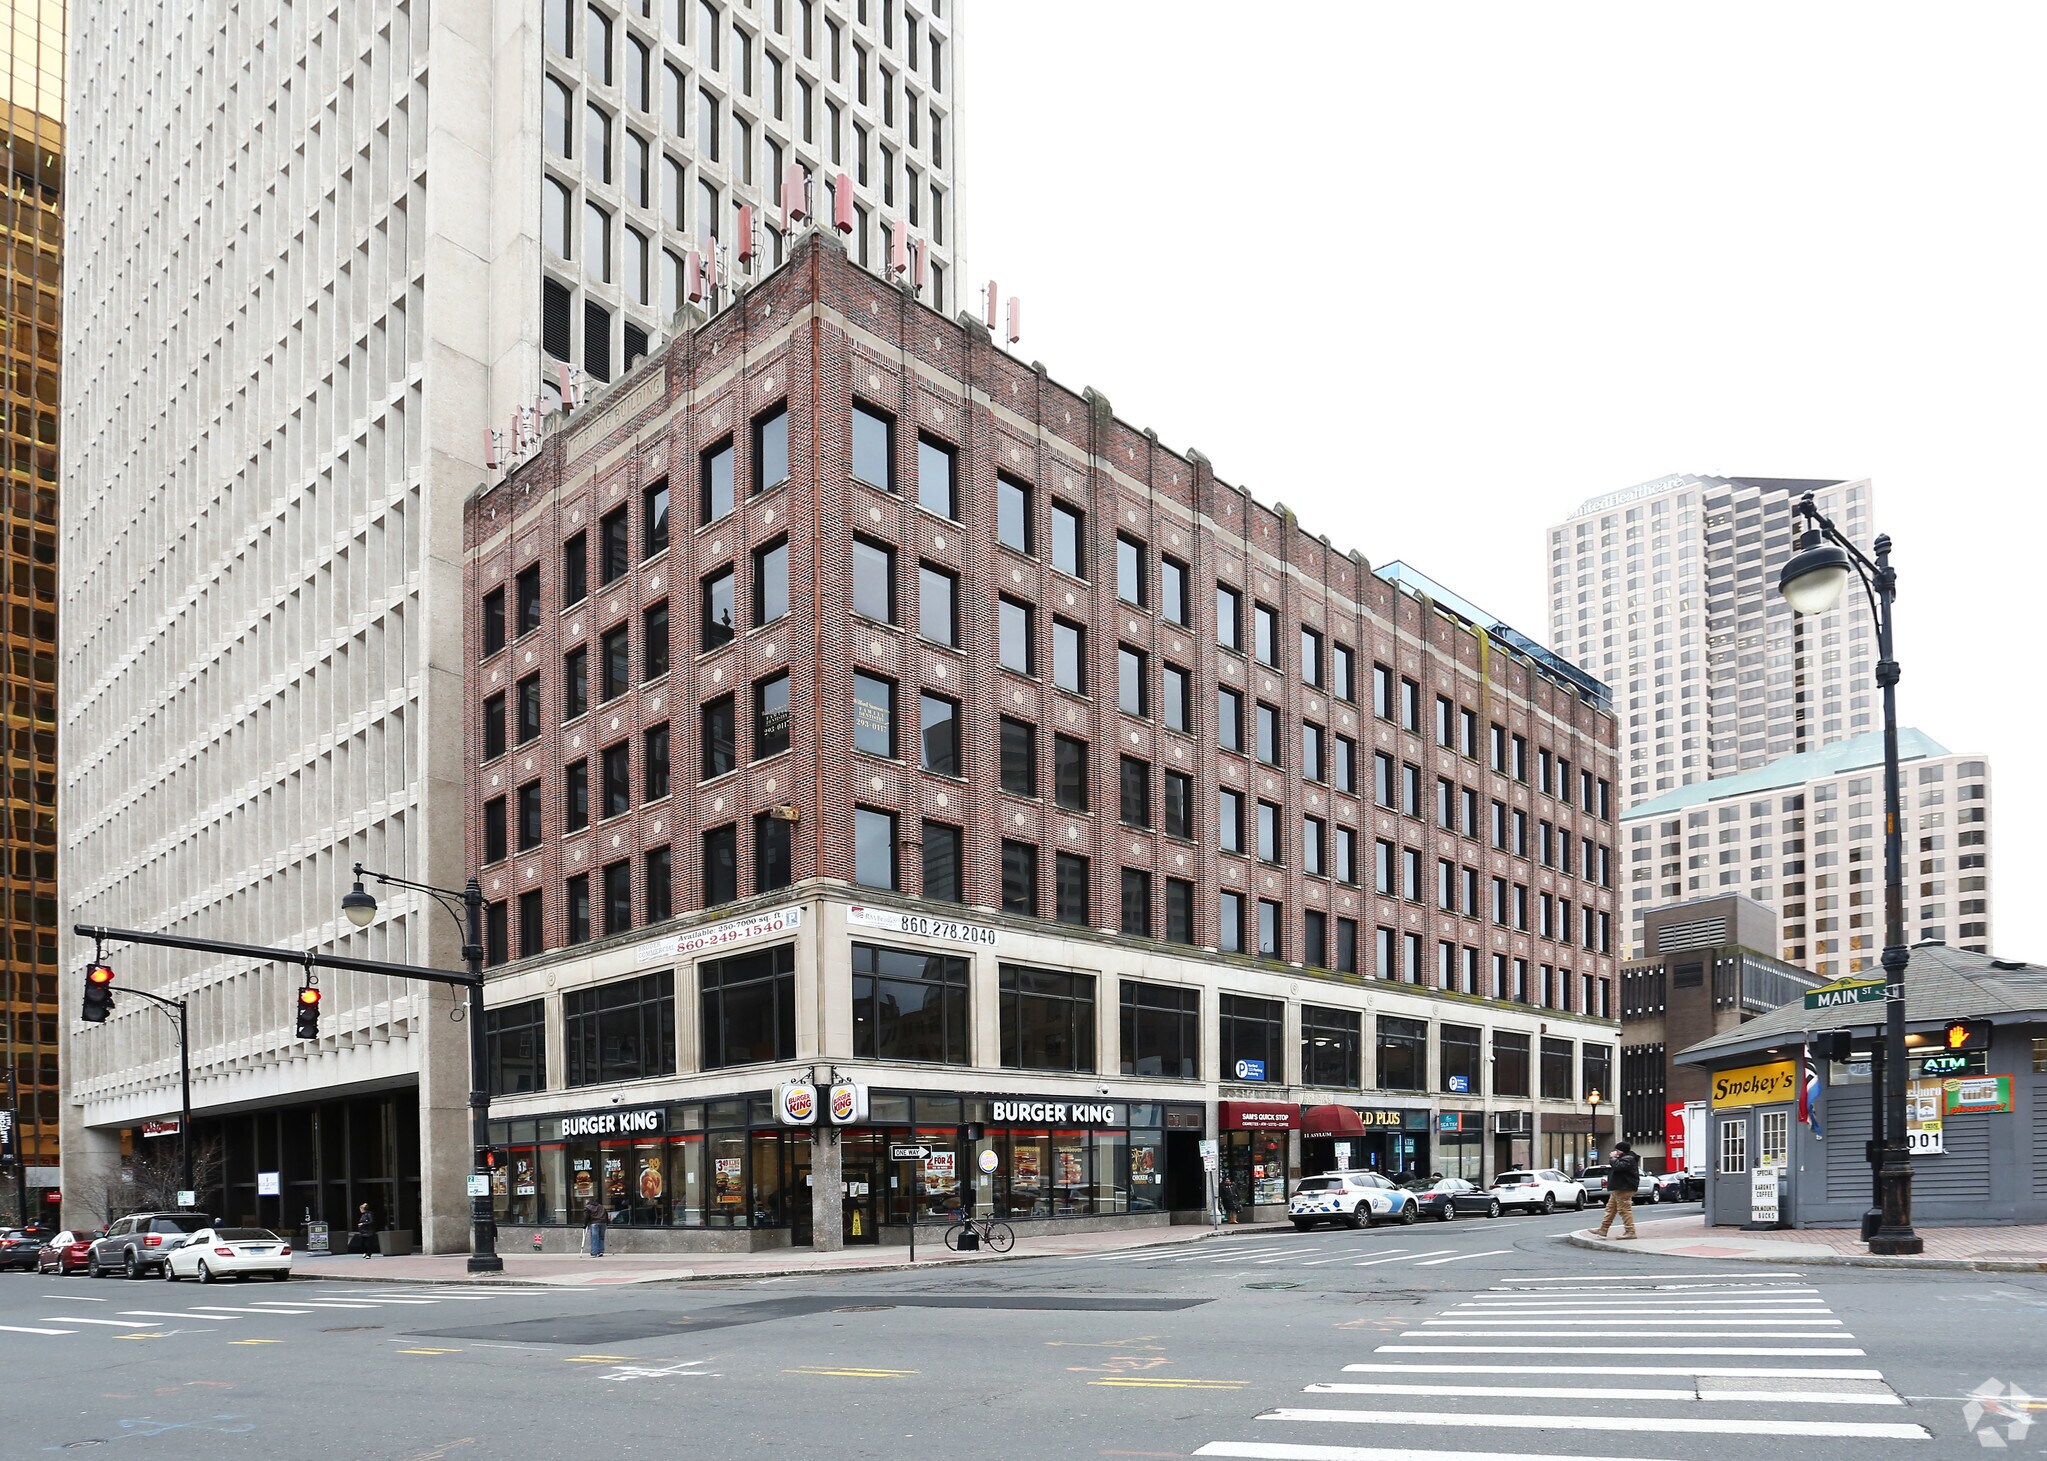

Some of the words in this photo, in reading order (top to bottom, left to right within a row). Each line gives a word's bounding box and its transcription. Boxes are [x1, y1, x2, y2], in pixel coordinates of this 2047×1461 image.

[572, 414, 612, 453] CORNING
[614, 379, 660, 422] BUILDING
[677, 920, 783, 952] 860-249-1540
[678, 927, 717, 941] Available:
[718, 917, 757, 932] 250-7000
[758, 916, 771, 924] sq.
[901, 916, 996, 945] 860.278.2040
[1818, 989, 1858, 1006] MAIN
[1862, 986, 1872, 994] ST
[1924, 1057, 1966, 1069] ATM
[1713, 1071, 1794, 1100] Smokey's
[788, 1093, 811, 1105] BURGER
[789, 1099, 812, 1113] KING
[833, 1092, 852, 1105] BURGER
[834, 1098, 852, 1114] KING
[993, 1102, 1067, 1122] BURGER
[1072, 1104, 1115, 1123] KING
[1356, 1111, 1373, 1125] LD
[1376, 1111, 1400, 1125] PLUS
[561, 1115, 616, 1136] BURGER
[619, 1110, 658, 1132] KING
[934, 1157, 946, 1165] FOR
[1756, 1169, 1773, 1177] SPECIAL
